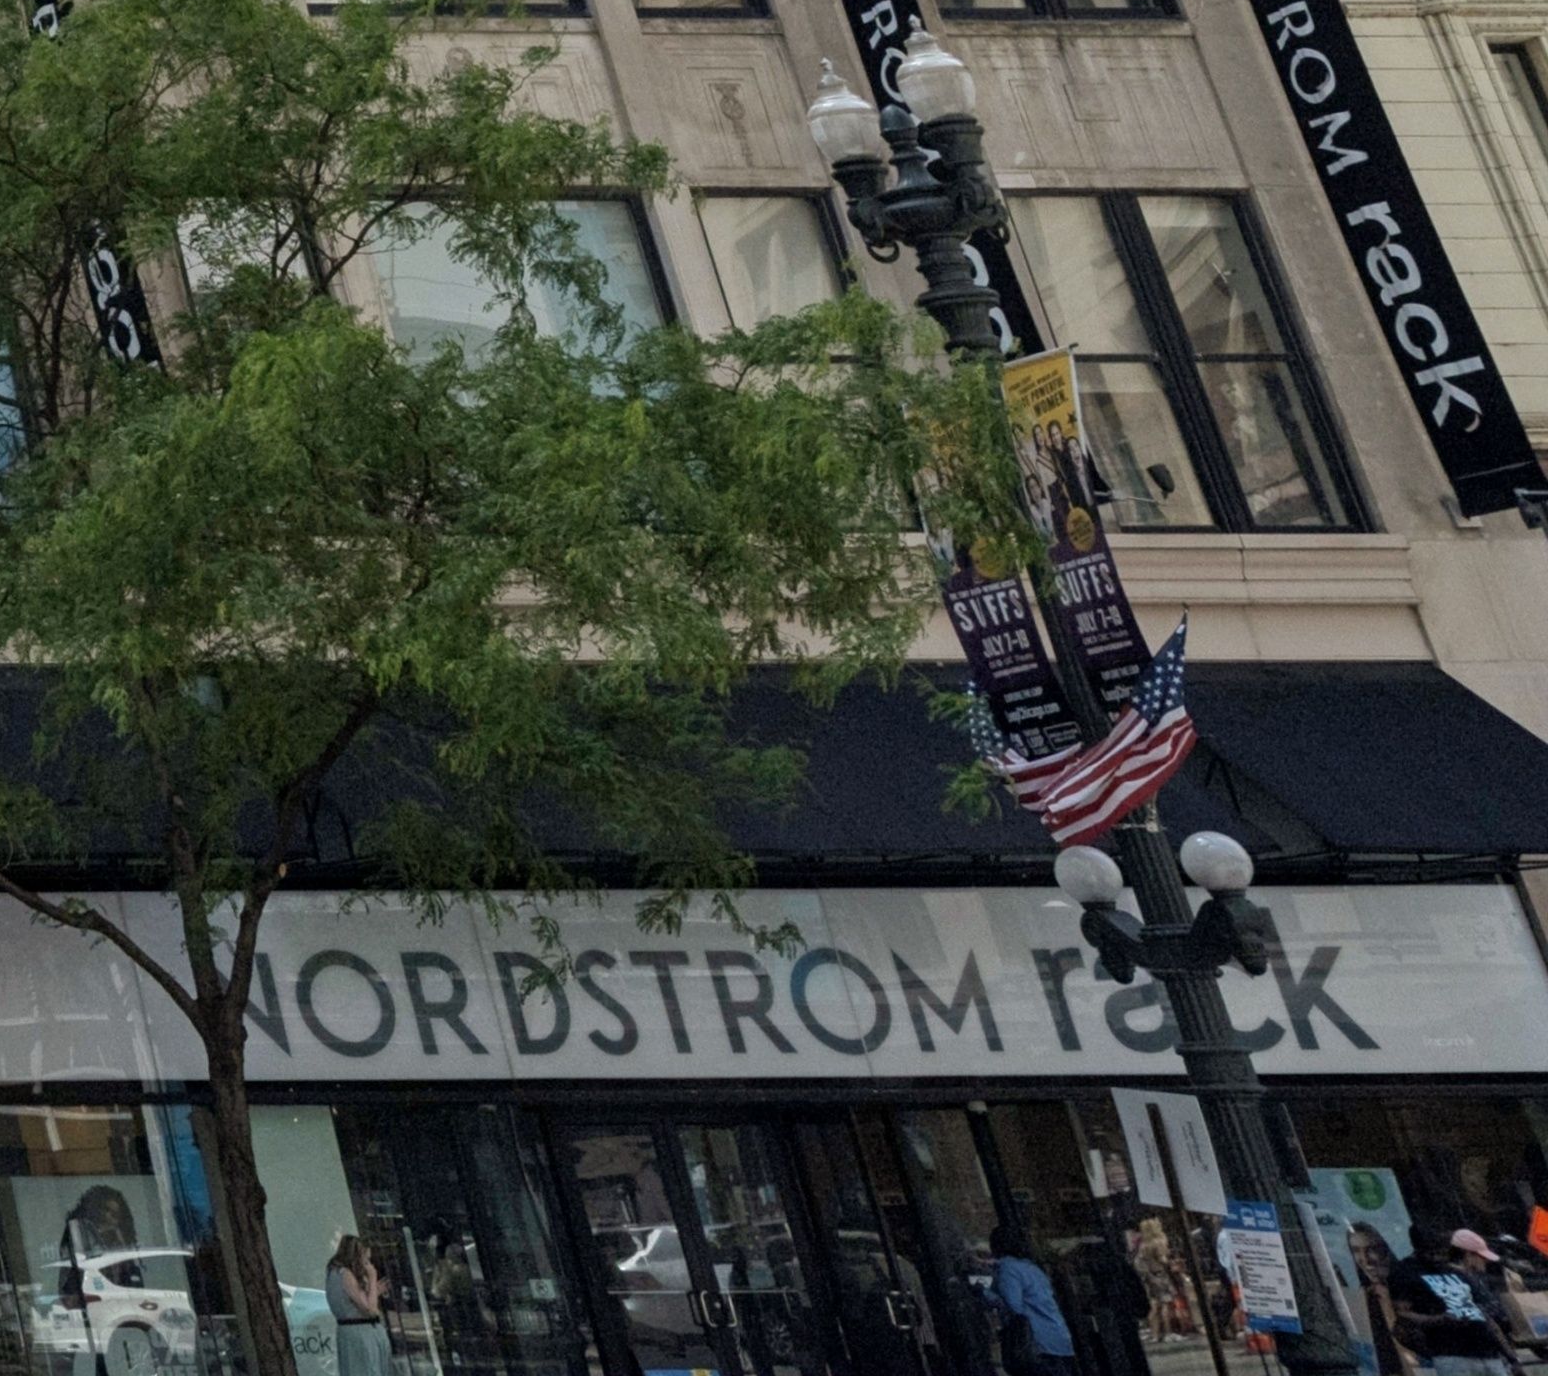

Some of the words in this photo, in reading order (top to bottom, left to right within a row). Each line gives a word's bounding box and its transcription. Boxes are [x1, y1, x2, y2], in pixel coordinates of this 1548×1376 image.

[1347, 199, 1486, 435] rack
[1056, 563, 1116, 606] SUFFS
[953, 589, 1024, 632] SUFFS
[293, 1331, 332, 1355] ack
